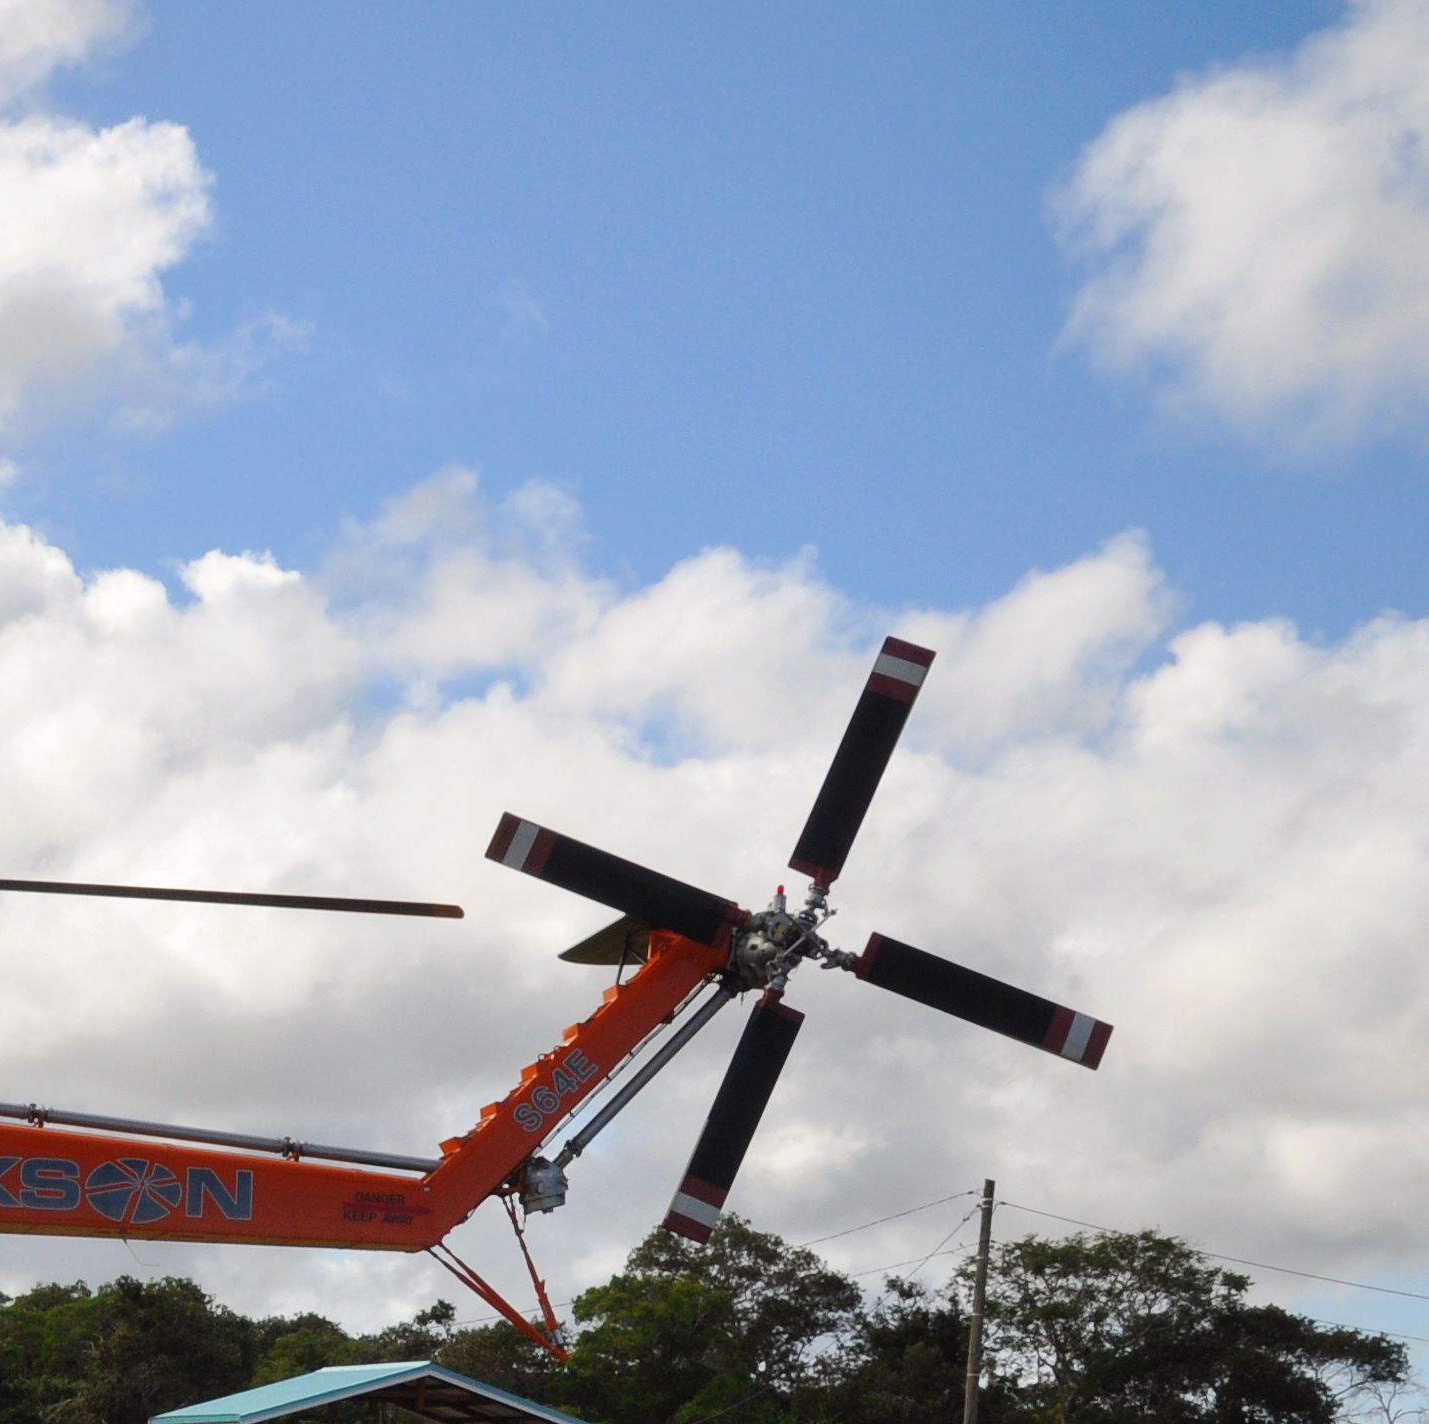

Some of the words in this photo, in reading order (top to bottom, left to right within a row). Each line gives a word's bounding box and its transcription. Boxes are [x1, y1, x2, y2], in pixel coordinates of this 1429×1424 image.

[513, 1048, 599, 1132] S64E
[354, 1191, 406, 1205] DANGER
[342, 1209, 378, 1223] KEEP
[382, 1212, 415, 1225] AWAY
